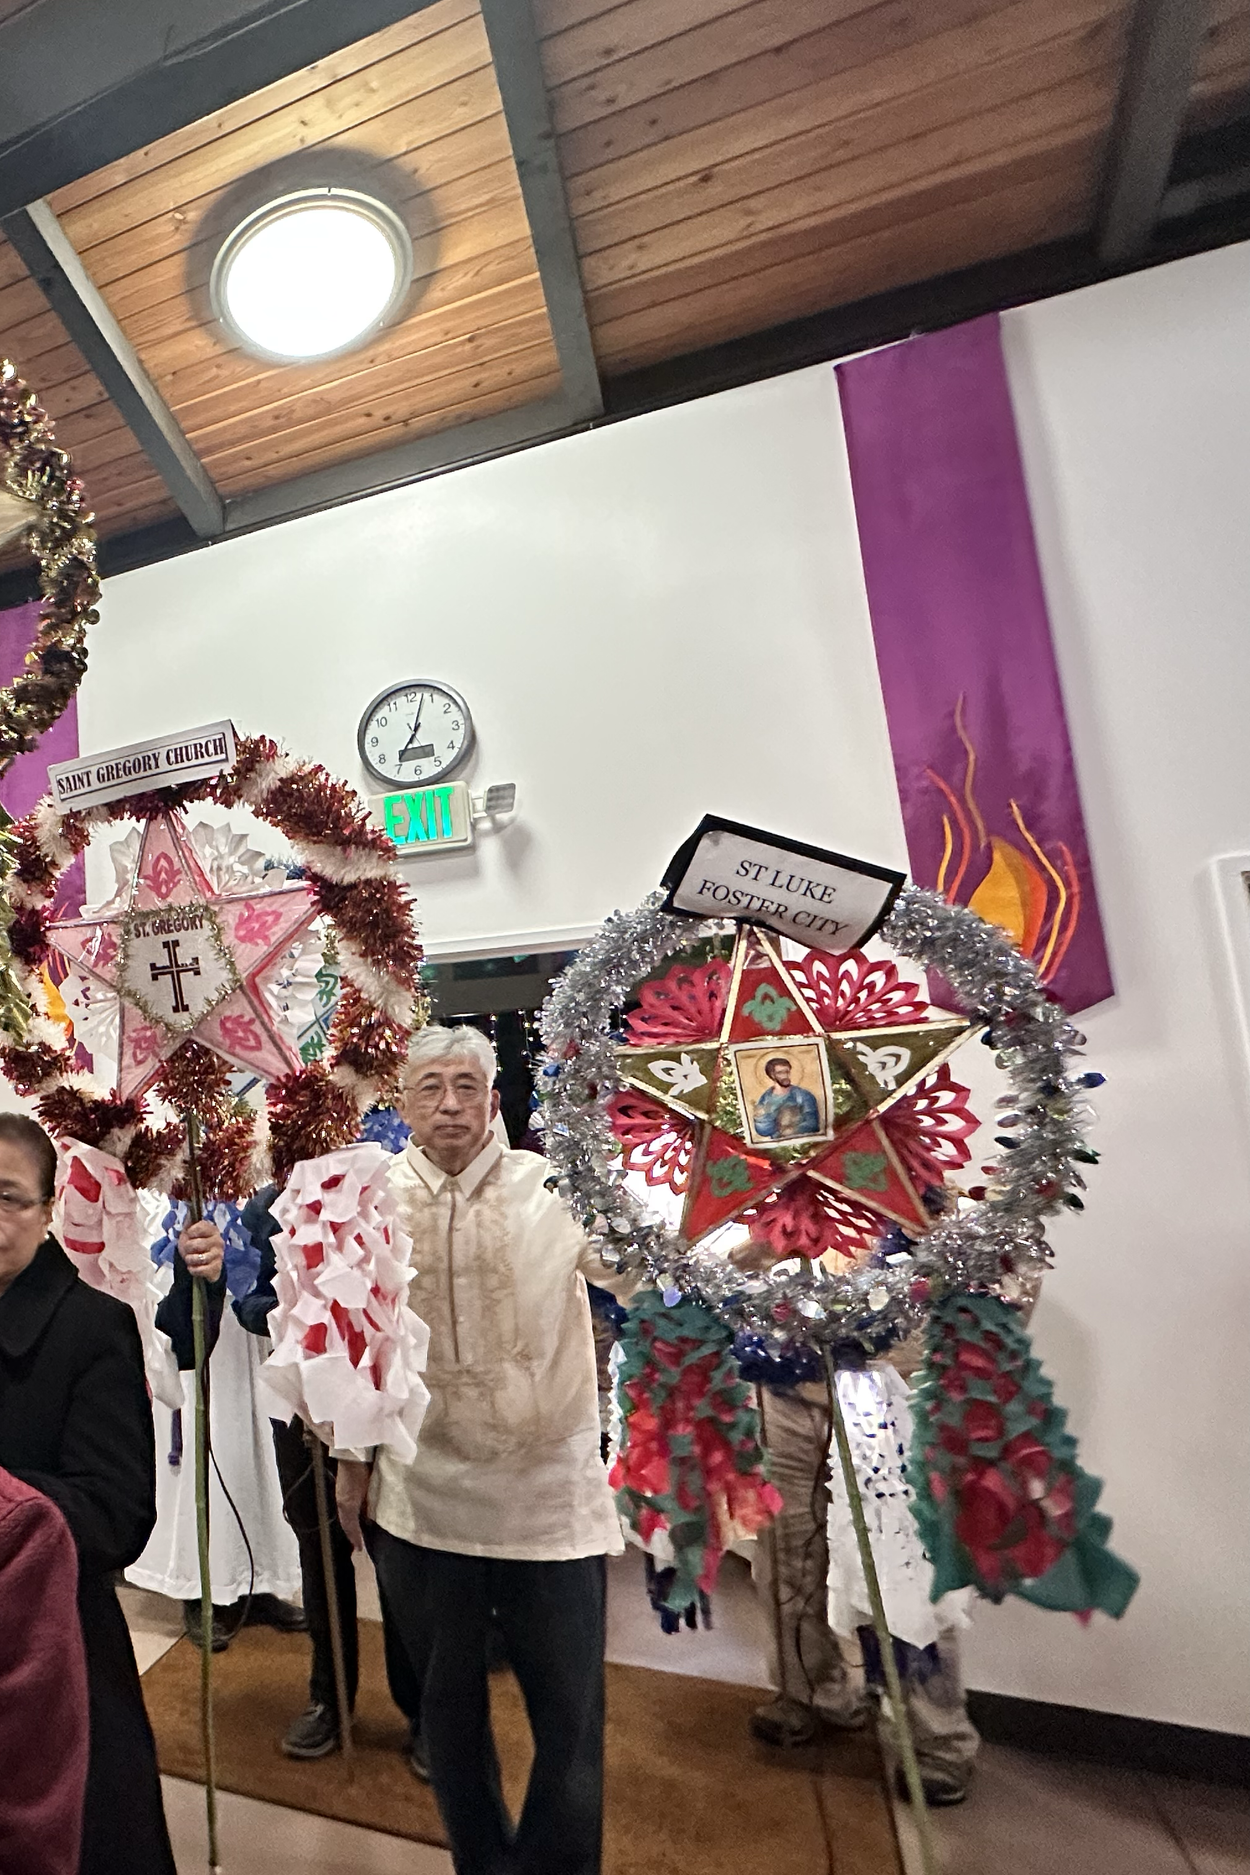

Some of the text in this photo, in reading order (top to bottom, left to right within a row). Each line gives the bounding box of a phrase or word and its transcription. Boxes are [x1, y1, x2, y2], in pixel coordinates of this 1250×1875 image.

[404, 691, 417, 703] 12
[429, 693, 434, 703] 1
[387, 701, 398, 712] 11
[443, 703, 451, 714] 2
[376, 716, 388, 728] 10
[452, 720, 460, 731] 3
[370, 736, 379, 747] 9
[447, 740, 456, 750] 4
[378, 753, 386, 764] 8
[433, 756, 442, 767] 5
[56, 737, 225, 795] SAINT GREGORY CHURCH
[395, 763, 403, 775] 7
[414, 765, 422, 776] 6
[383, 786, 454, 845] EXIT
[735, 859, 837, 904] ST LUKE
[697, 879, 850, 936] FOSTER CITY
[133, 913, 204, 938] ST. GREGORY
